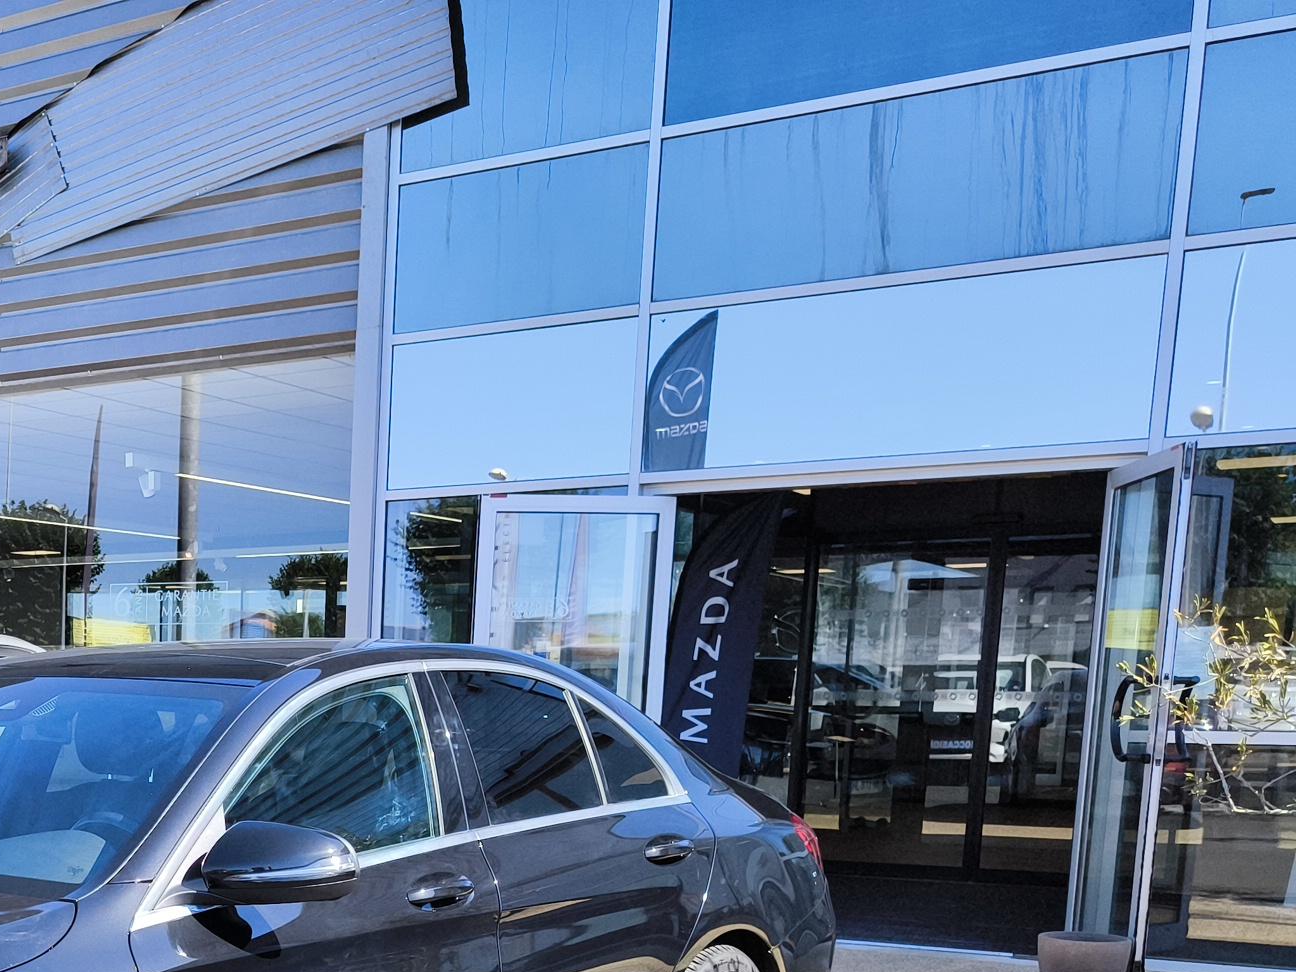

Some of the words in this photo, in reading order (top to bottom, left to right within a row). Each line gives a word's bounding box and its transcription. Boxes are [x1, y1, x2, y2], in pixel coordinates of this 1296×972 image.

[656, 420, 708, 440] mazda
[155, 589, 220, 602] GARANTIE
[161, 606, 210, 618] MAZDA
[679, 558, 739, 744] MAZDA
